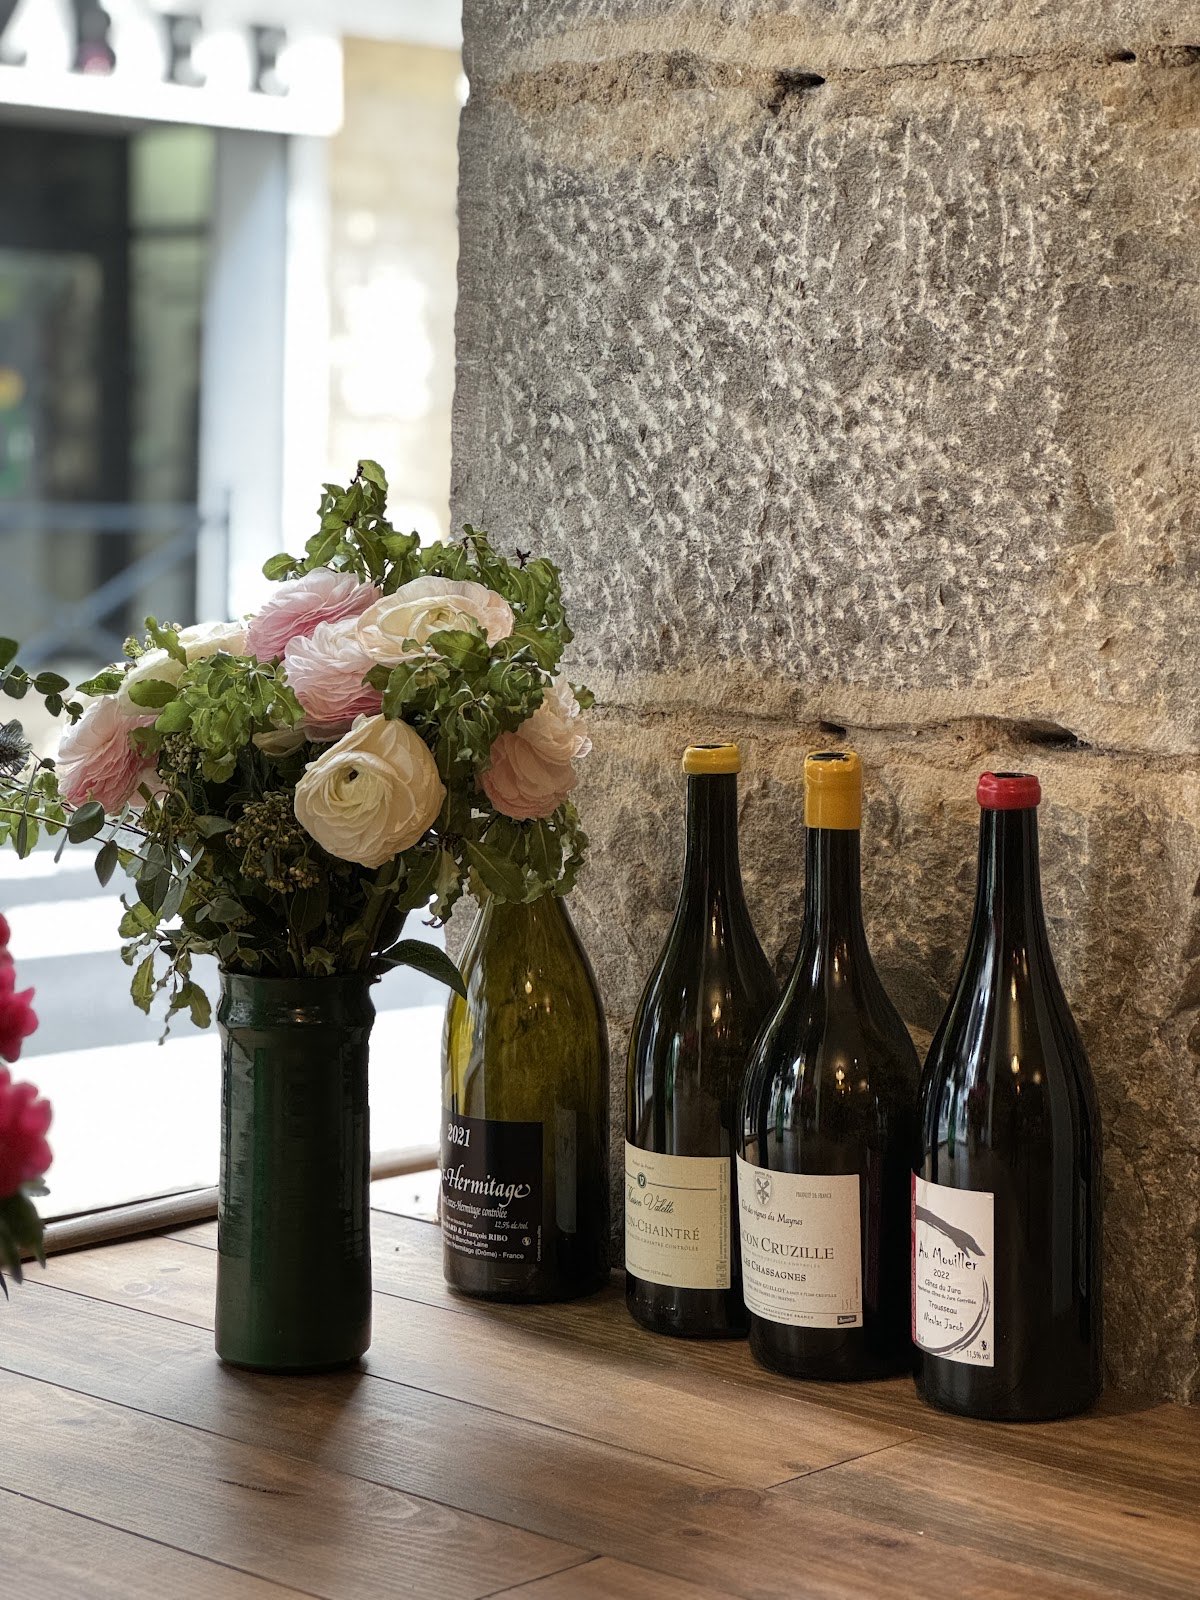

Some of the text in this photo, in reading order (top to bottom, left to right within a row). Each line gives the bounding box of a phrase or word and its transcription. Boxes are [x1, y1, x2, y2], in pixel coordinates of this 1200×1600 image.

[447, 1123, 471, 1147] 2021
[644, 1191, 674, 1214] Valette
[768, 1212, 774, 1221] du
[777, 1212, 803, 1228] Maynes
[463, 1228, 487, 1240] François
[488, 1233, 508, 1242] RIBO
[502, 1252, 524, 1260] France
[761, 1238, 834, 1260] CRUZILLE
[918, 1240, 979, 1270] Au Mouiller
[752, 1260, 807, 1282] CHASSAGNES
[933, 1268, 950, 1280] 2022
[947, 1285, 962, 1295] Jura
[928, 1299, 958, 1315] Trousseau
[944, 1318, 964, 1332] Jacob
[982, 1352, 990, 1360] vol
